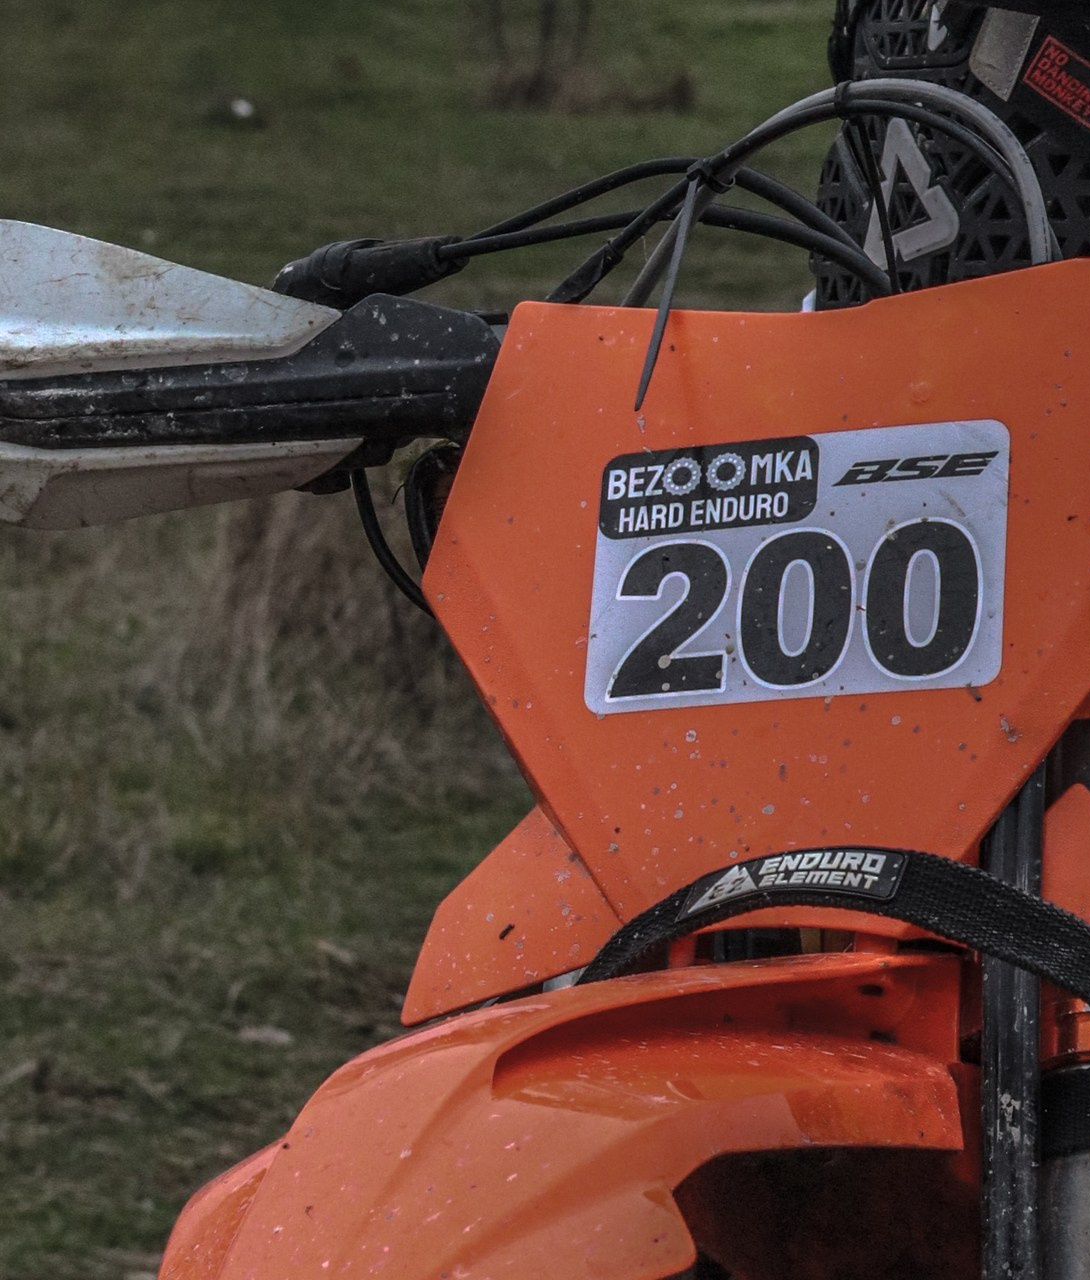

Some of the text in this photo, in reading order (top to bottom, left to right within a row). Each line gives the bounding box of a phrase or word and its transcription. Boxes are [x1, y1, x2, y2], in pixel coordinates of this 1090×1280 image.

[1044, 45, 1069, 66] NO
[832, 451, 999, 487] BSE
[618, 492, 789, 533] HARD ENDURO
[608, 517, 984, 700] 200
[758, 852, 886, 875] ENDURO
[758, 871, 879, 889] ELEMENT
